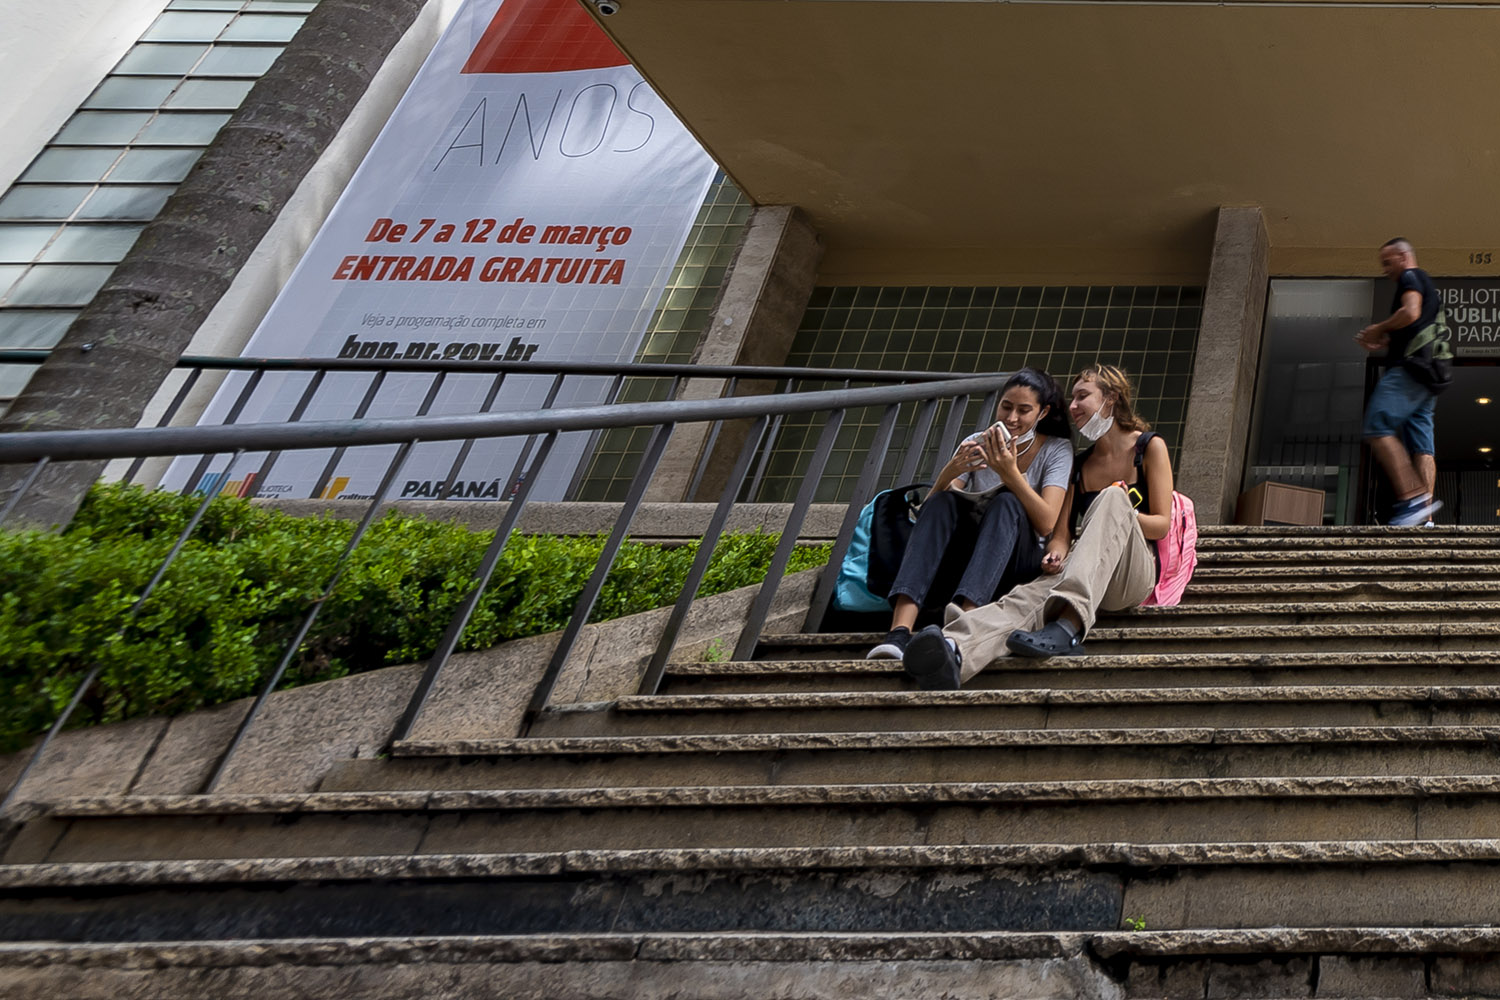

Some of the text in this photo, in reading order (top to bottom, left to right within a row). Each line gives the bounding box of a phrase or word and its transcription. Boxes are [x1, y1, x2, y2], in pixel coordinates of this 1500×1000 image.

[432, 80, 655, 171] ANOS
[365, 217, 632, 254] De 7 a 12 de março
[332, 255, 626, 285] ENTRADA GRATUITA
[1469, 252, 1492, 264] 155
[361, 313, 547, 331] Veja a programação completa em
